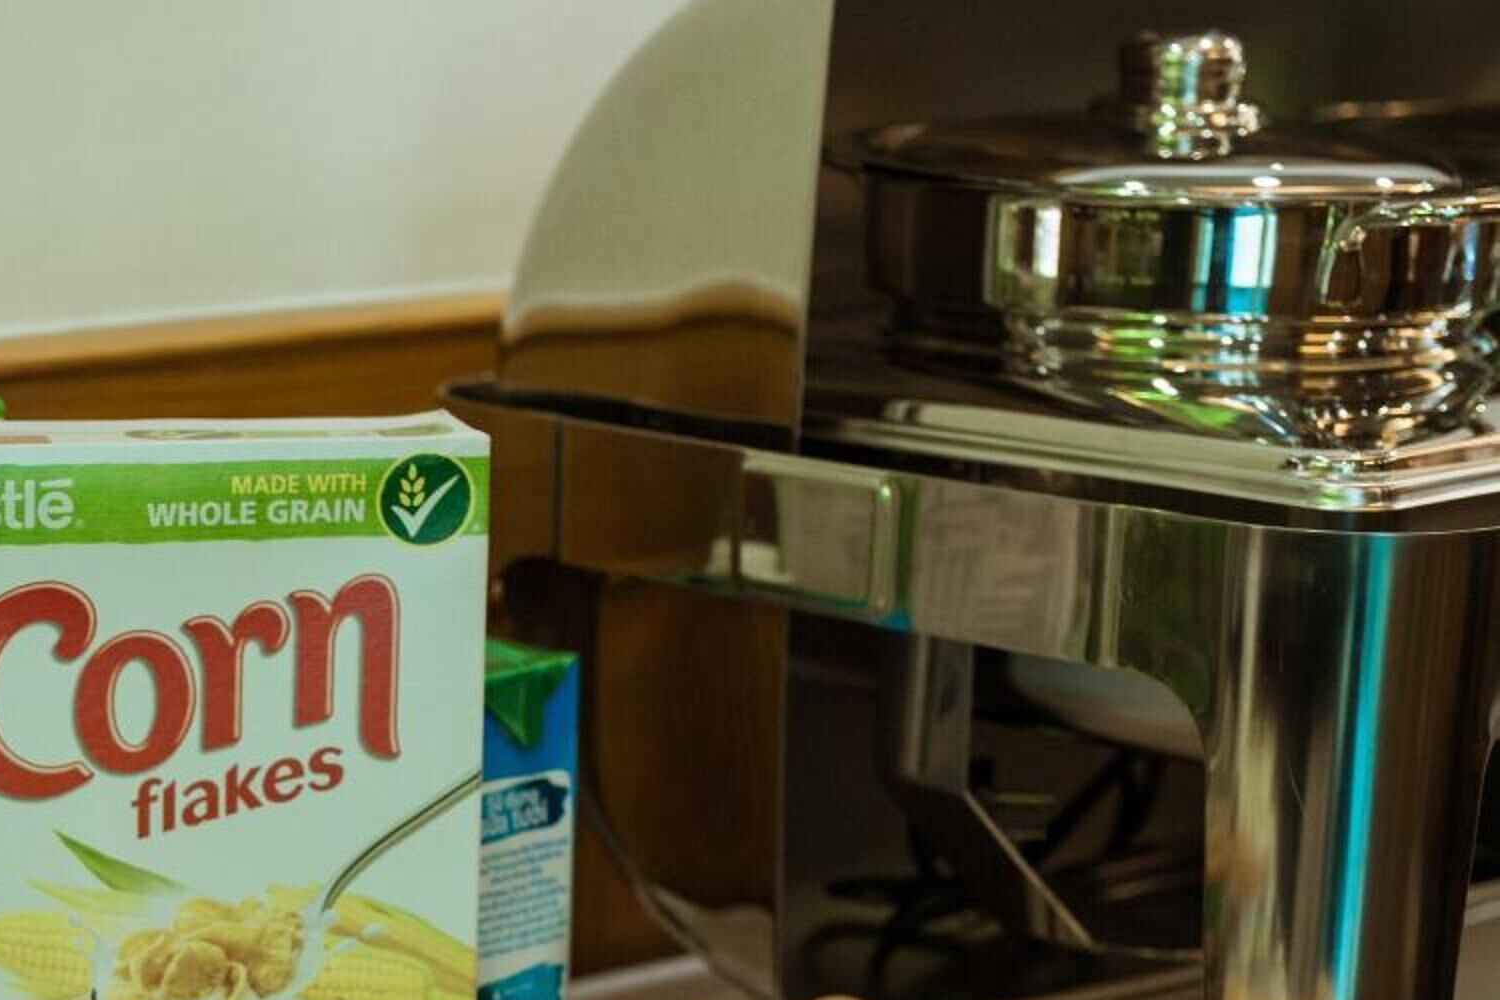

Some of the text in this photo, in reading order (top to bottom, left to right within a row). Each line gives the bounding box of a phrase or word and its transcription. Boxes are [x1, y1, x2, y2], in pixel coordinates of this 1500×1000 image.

[230, 473, 367, 497] MADE WITH
[147, 498, 367, 529] WHOLE GRAIN
[131, 746, 345, 839] flakes
